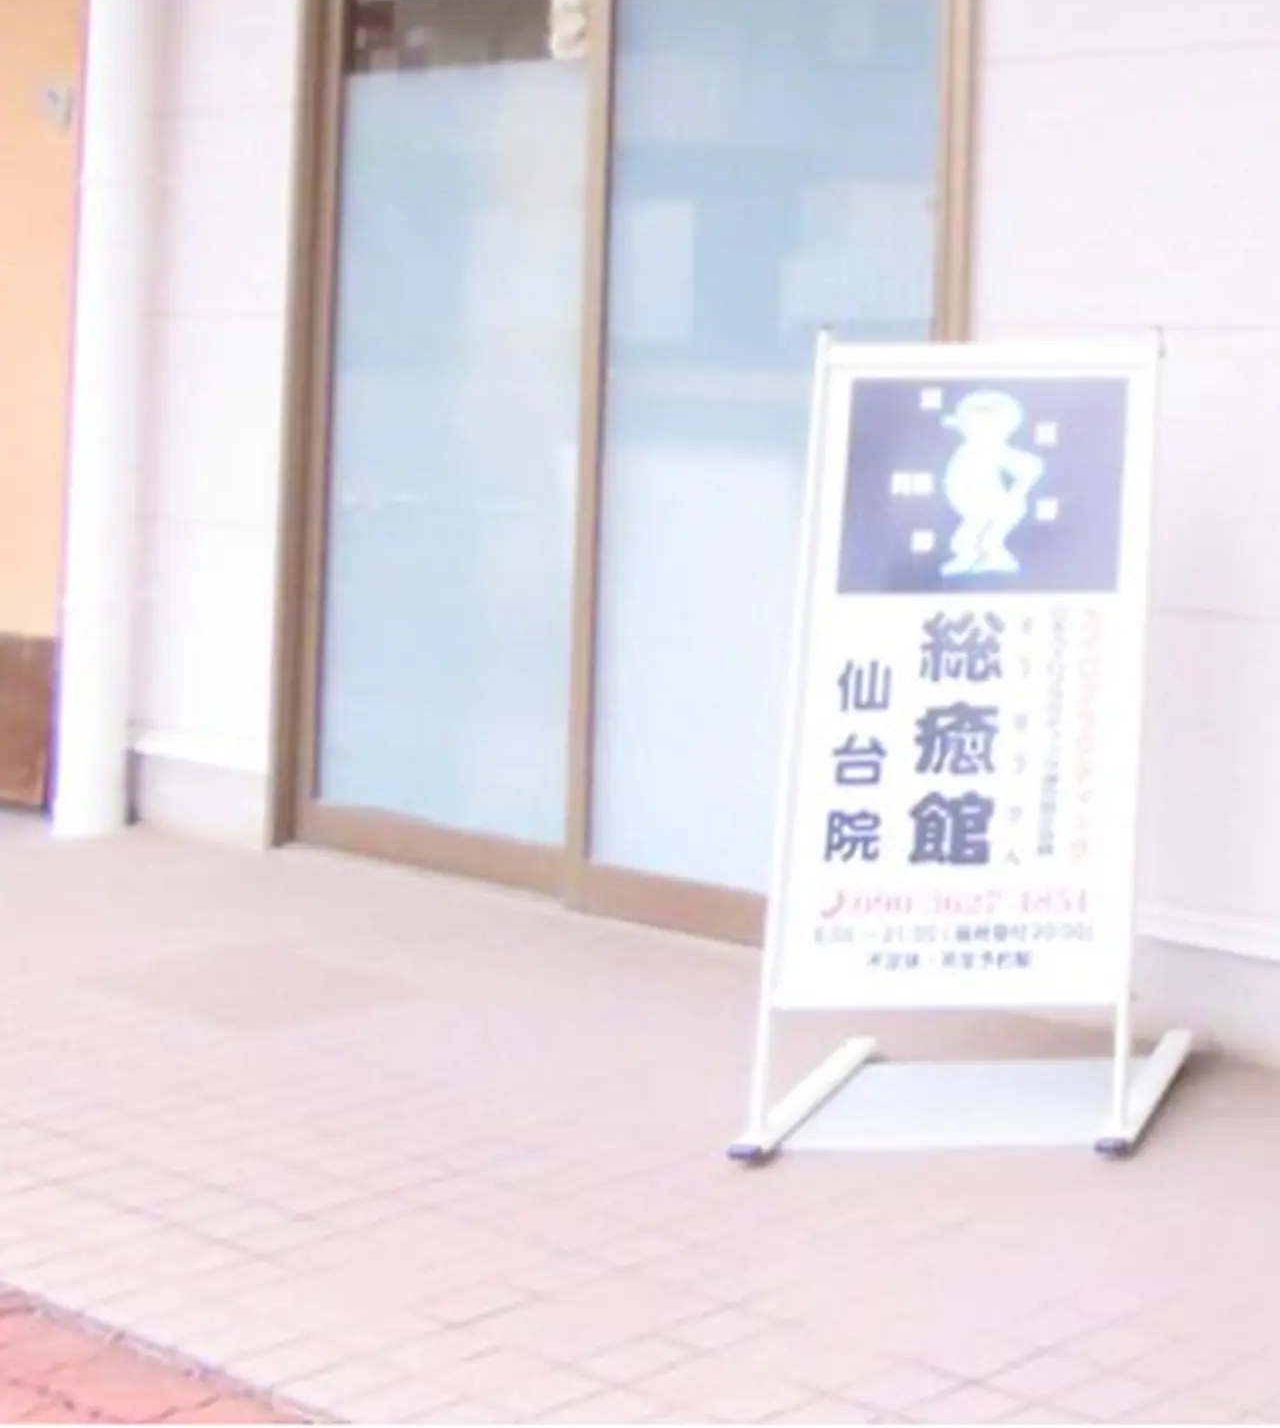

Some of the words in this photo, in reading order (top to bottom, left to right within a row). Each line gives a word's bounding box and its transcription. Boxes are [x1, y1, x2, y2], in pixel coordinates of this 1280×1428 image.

[823, 658, 893, 863] 仙台院
[908, 610, 1004, 865] 総癒館
